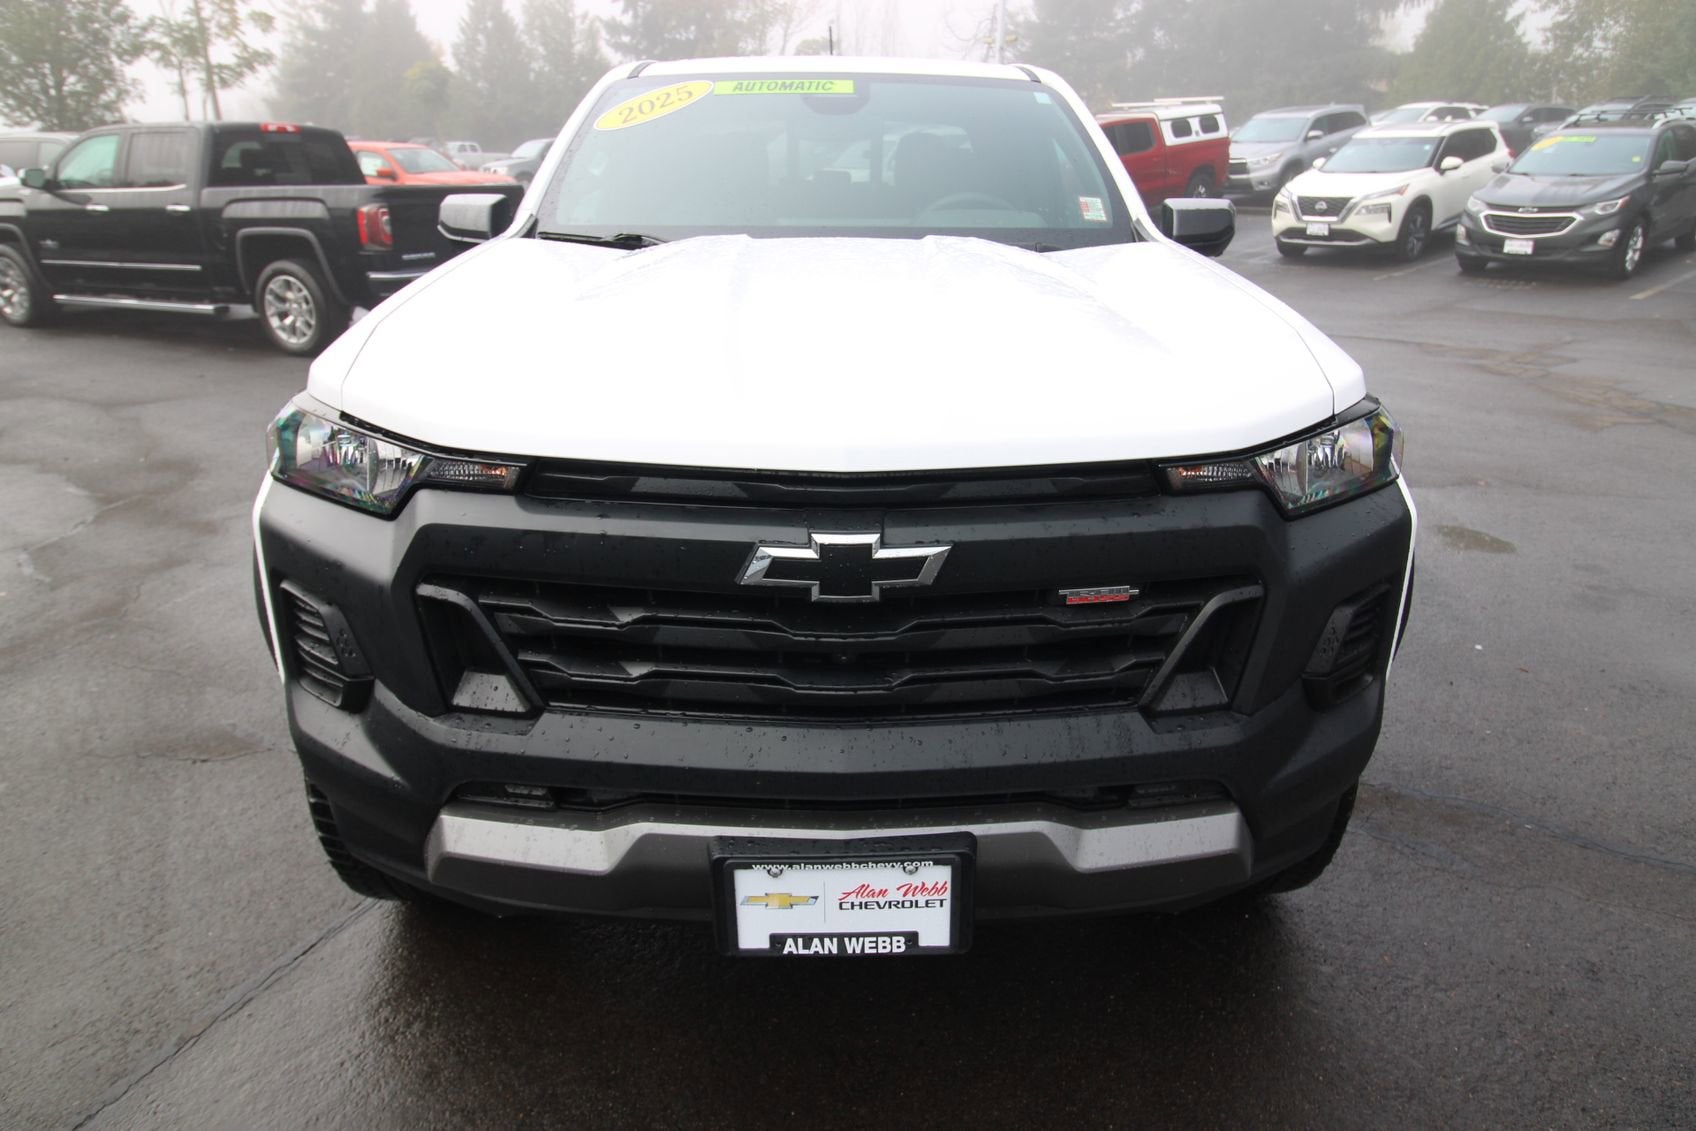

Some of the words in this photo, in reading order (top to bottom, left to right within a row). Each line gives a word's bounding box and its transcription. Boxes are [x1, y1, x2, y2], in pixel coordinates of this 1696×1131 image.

[732, 80, 835, 92] AUTOMATIC
[618, 84, 694, 124] 2025
[838, 883, 889, 901] Alan
[896, 880, 948, 897] Webb
[838, 898, 948, 911] CHEVROLET
[782, 937, 838, 955] ALAN
[844, 936, 906, 954] WEBB
